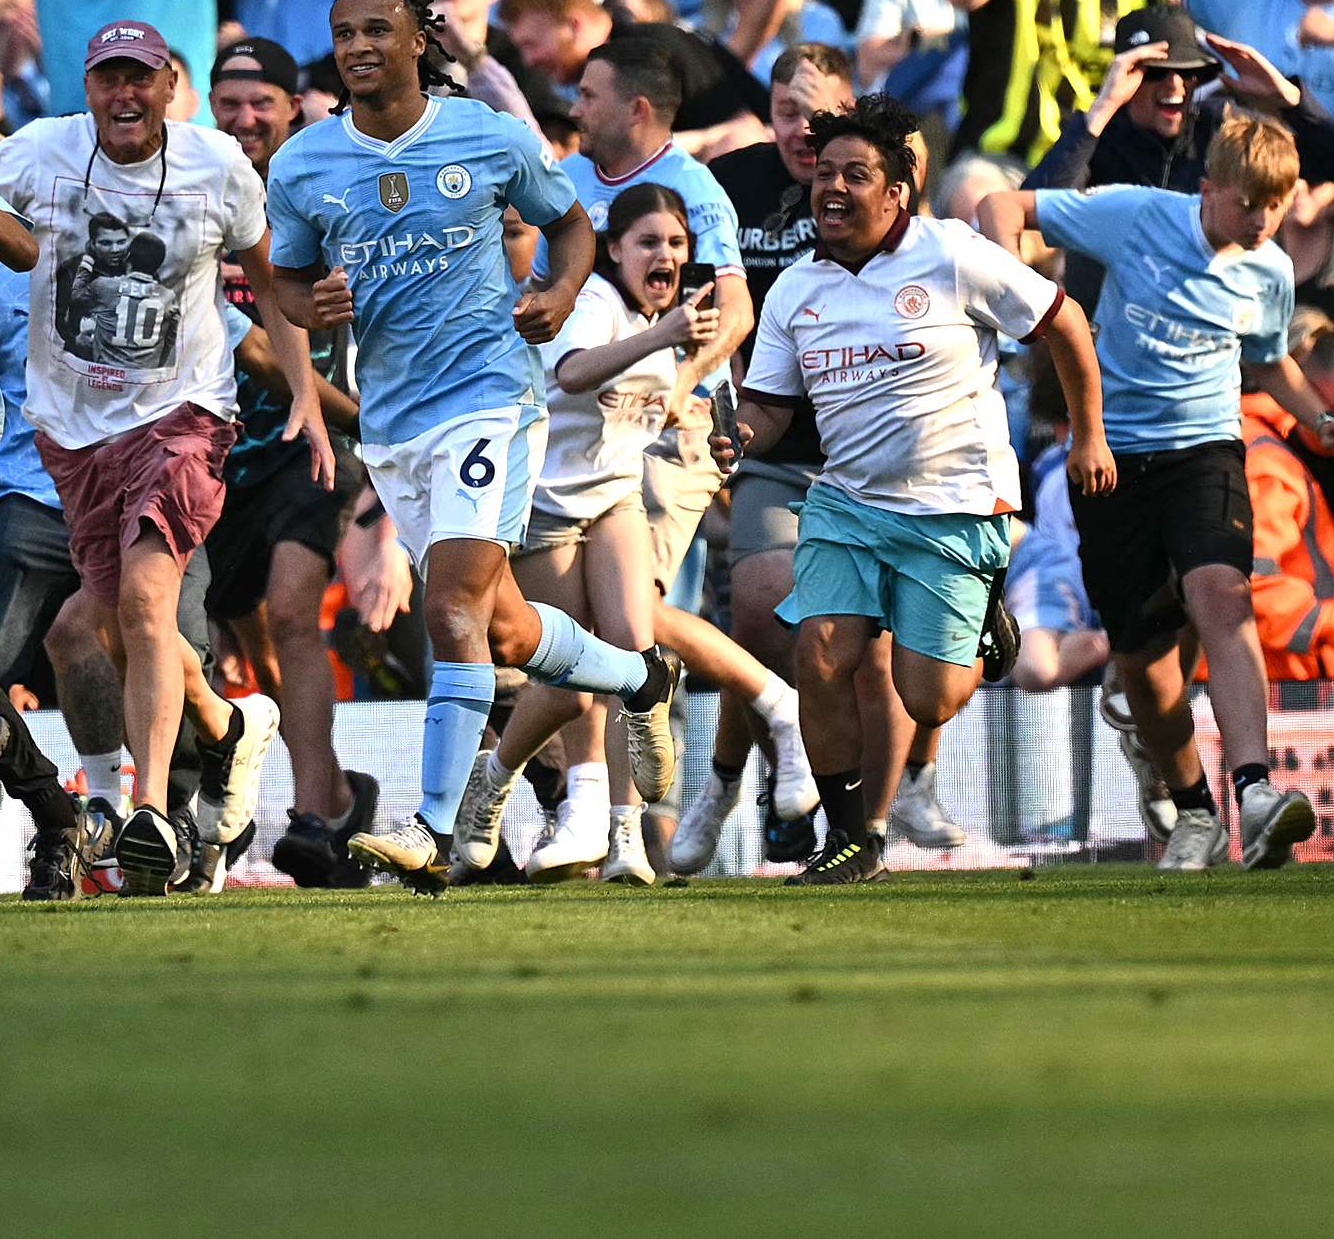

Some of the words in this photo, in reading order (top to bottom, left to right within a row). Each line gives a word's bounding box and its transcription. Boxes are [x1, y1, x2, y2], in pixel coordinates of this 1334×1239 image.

[340, 225, 475, 264] ETIHAD
[358, 256, 449, 281] AIRWAYS
[112, 295, 165, 347] 10
[802, 342, 926, 370] ETIHAD
[88, 365, 126, 379] INSPIRED
[821, 367, 900, 384] AIRWAYS
[88, 380, 124, 392] LEGENDS
[598, 391, 666, 412] ETIHA
[460, 438, 496, 488] 6
